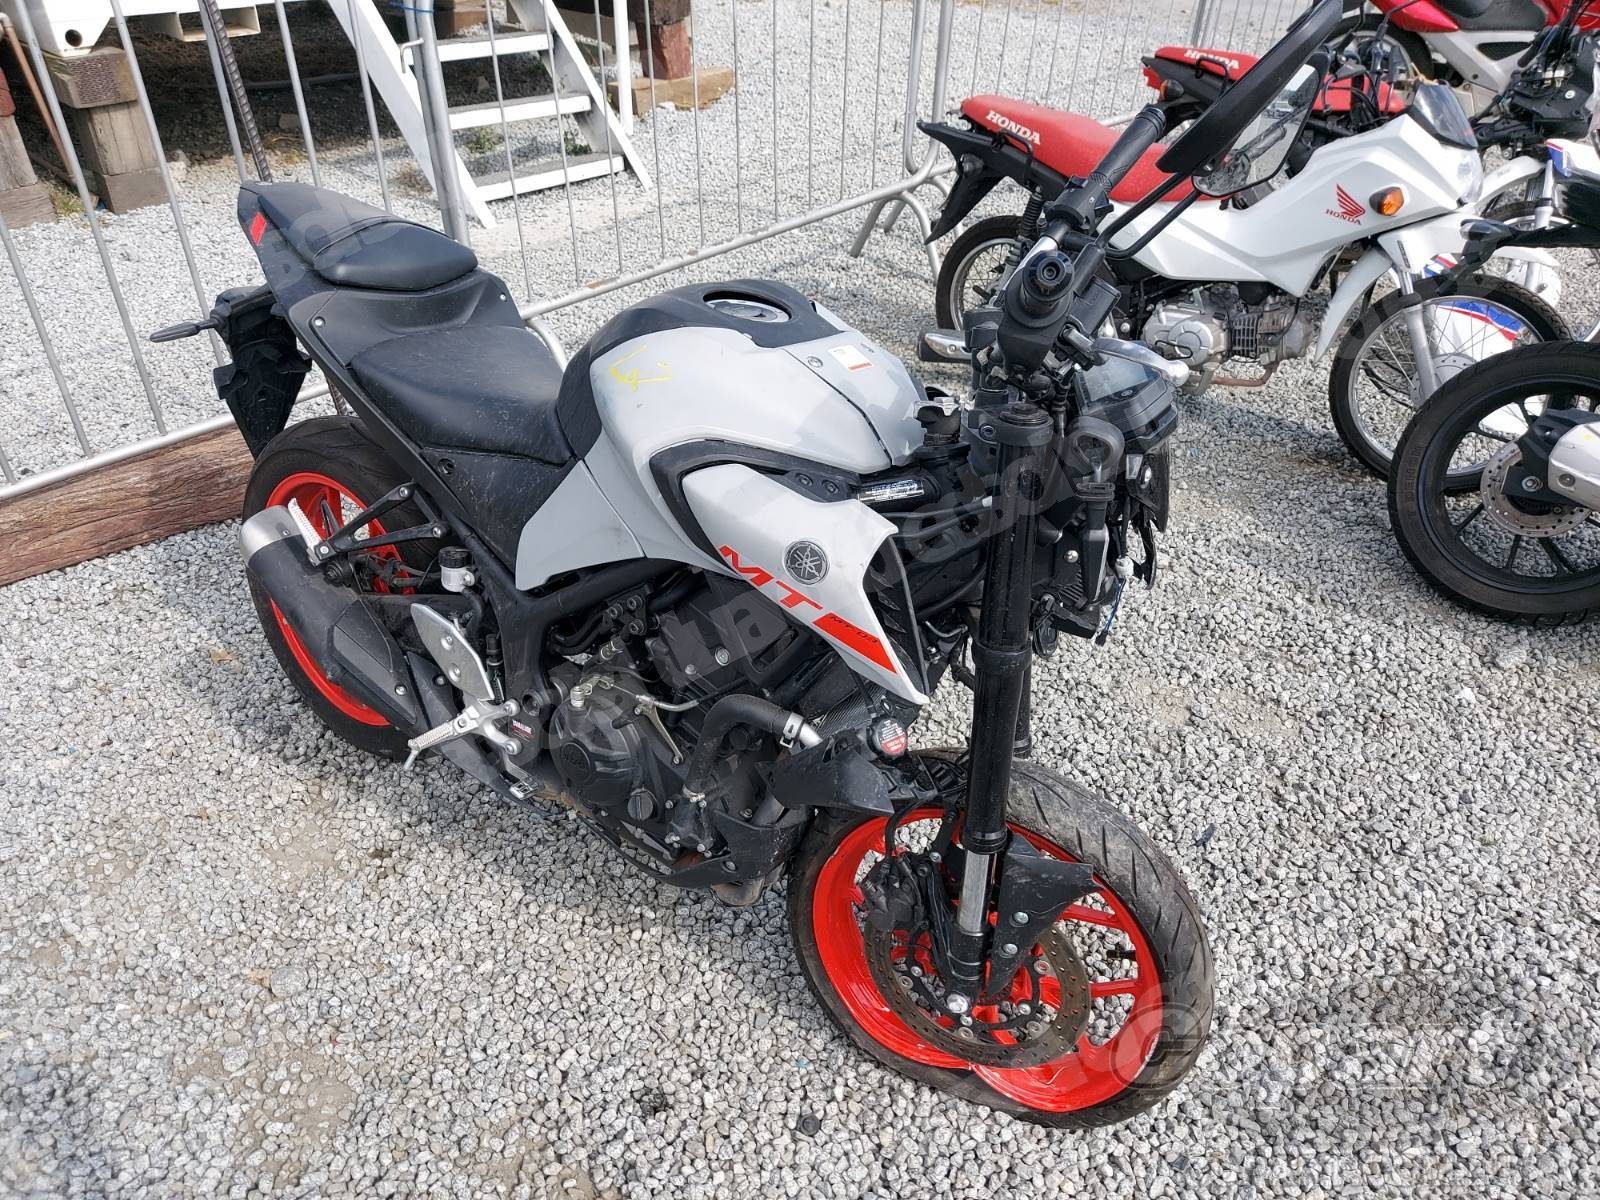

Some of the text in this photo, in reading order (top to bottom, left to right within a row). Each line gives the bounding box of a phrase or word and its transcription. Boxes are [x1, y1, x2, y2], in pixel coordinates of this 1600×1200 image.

[986, 109, 1041, 145] HONDA
[1325, 208, 1362, 226] HONDA
[719, 545, 823, 611] MT
